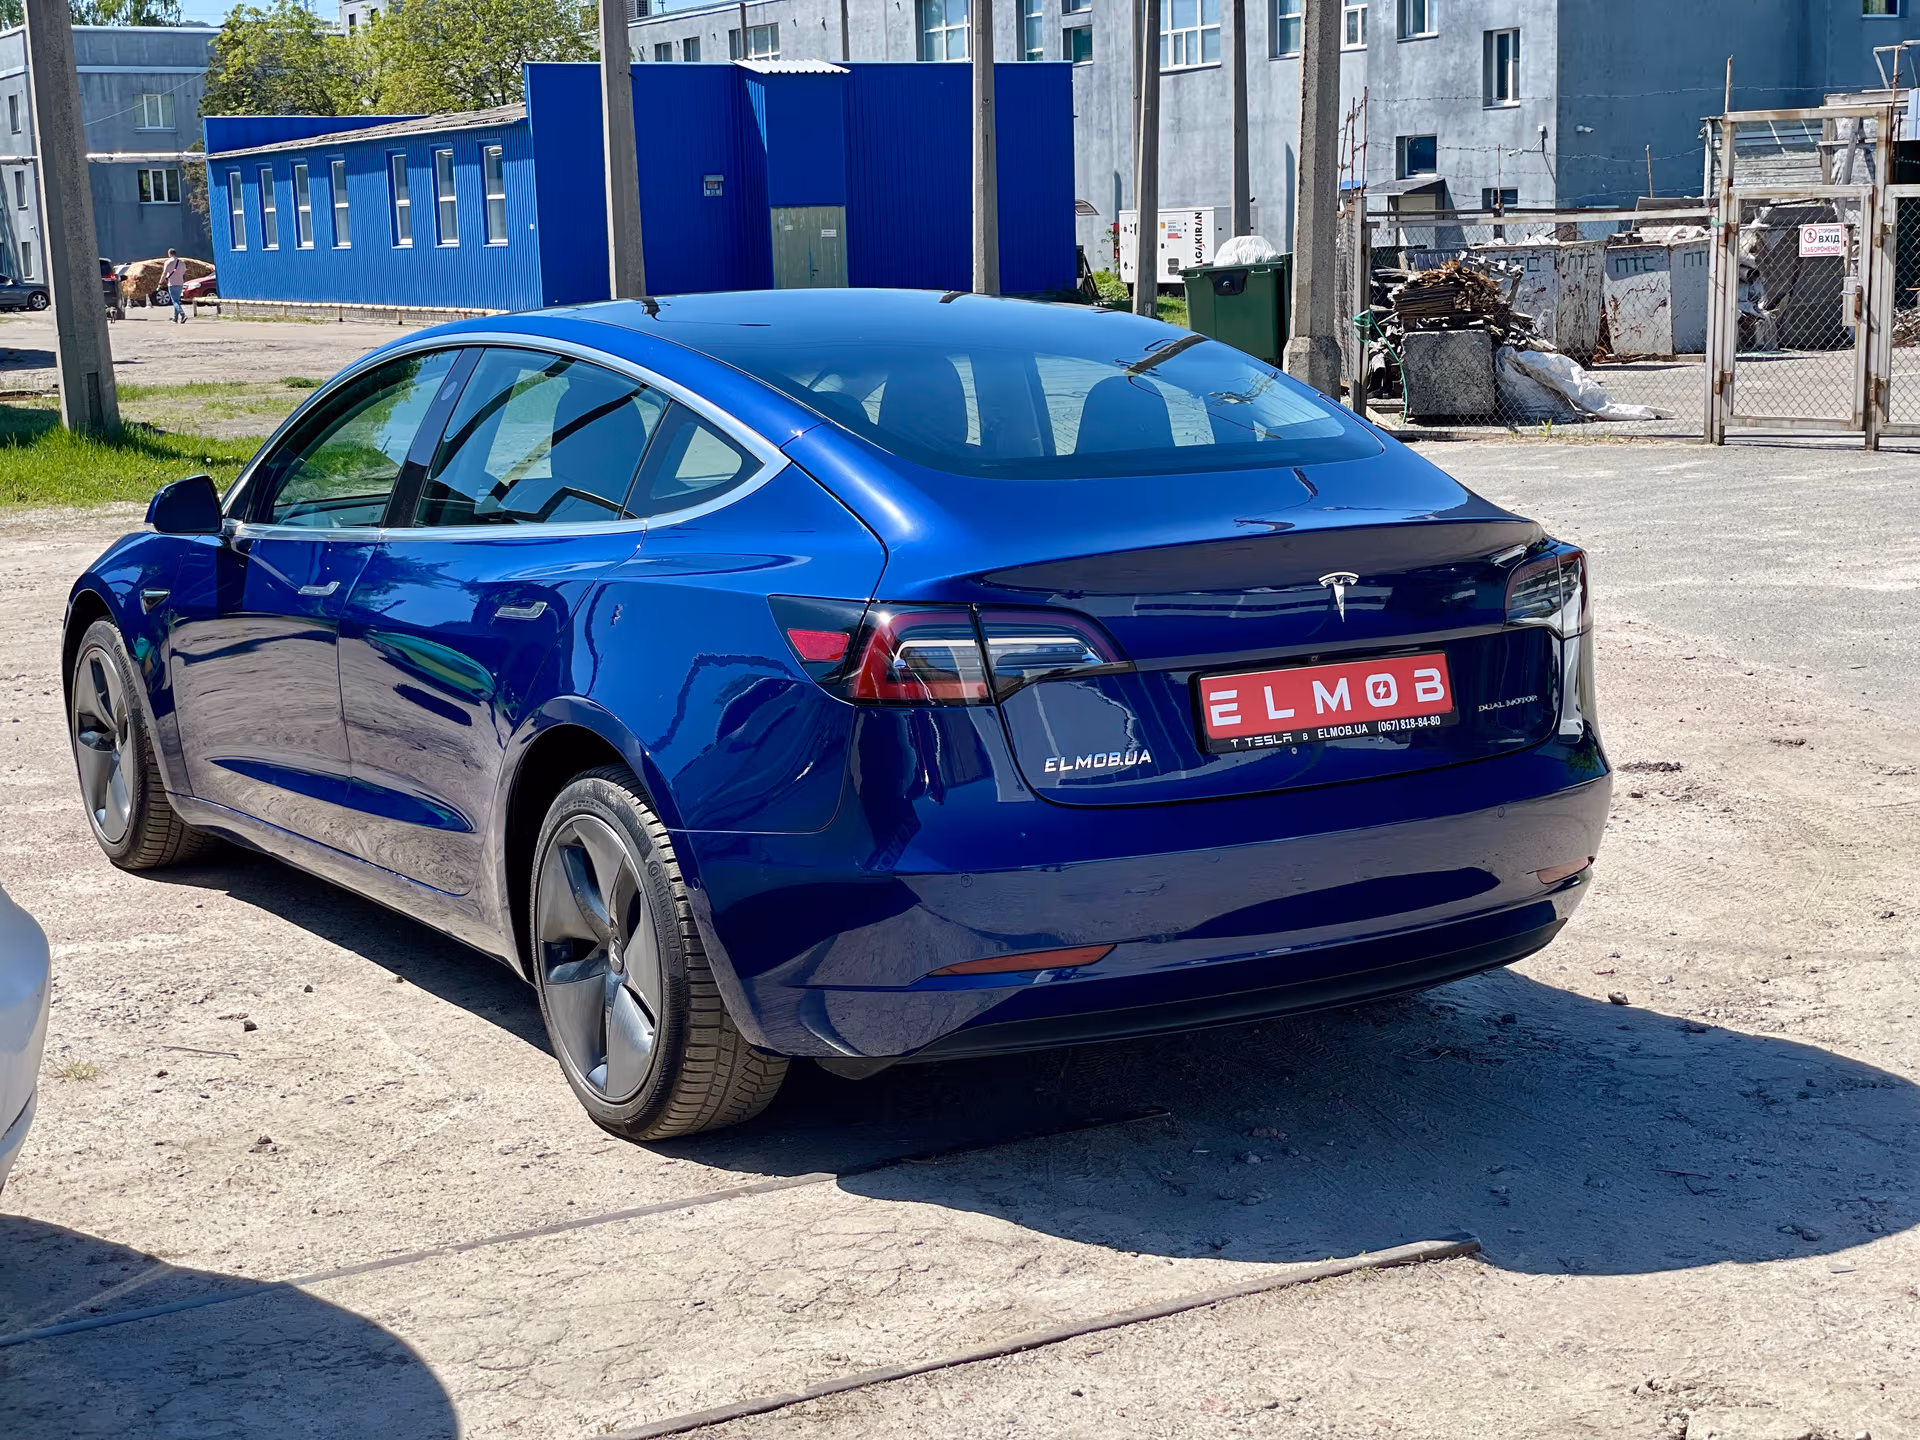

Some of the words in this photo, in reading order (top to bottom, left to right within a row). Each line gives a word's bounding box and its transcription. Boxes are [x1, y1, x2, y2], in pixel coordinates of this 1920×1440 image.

[1818, 234, 1840, 244] ВХІД
[1478, 701, 1505, 712] DUAL
[1506, 695, 1538, 707] MOTOR
[1245, 733, 1293, 747] TESLA
[1317, 722, 1369, 739] ELMOB.UA
[1378, 719, 1399, 732] (067)
[1400, 715, 1441, 729] 818-84-80
[1044, 749, 1152, 772] ELMOB.UA
[648, 860, 681, 951] Continental
